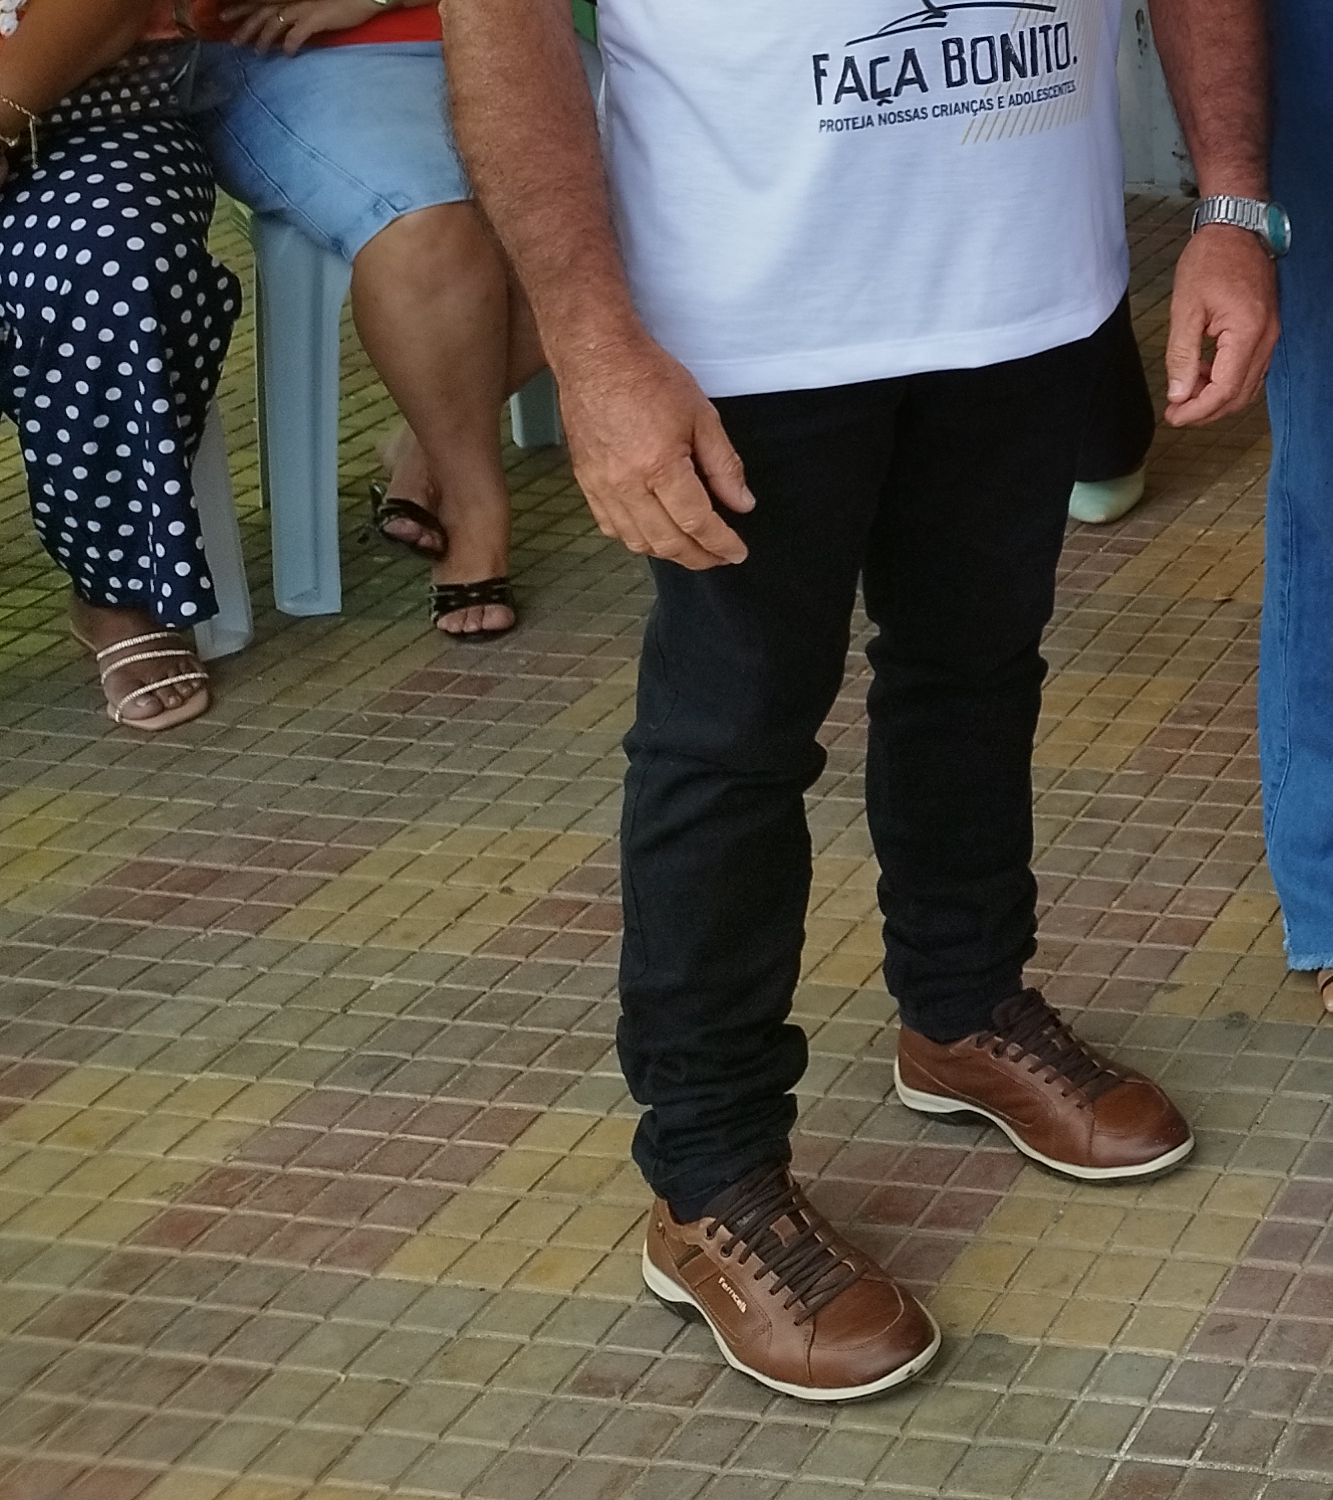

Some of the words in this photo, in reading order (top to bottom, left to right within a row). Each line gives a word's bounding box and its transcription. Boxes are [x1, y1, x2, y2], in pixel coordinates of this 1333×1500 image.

[812, 47, 929, 107] FAÇA
[941, 21, 1078, 89] BONITO.
[818, 115, 875, 133] PROTEJA
[877, 107, 929, 127] NOSSAS
[931, 98, 994, 118] CRIANÇAS
[997, 96, 1005, 109] E
